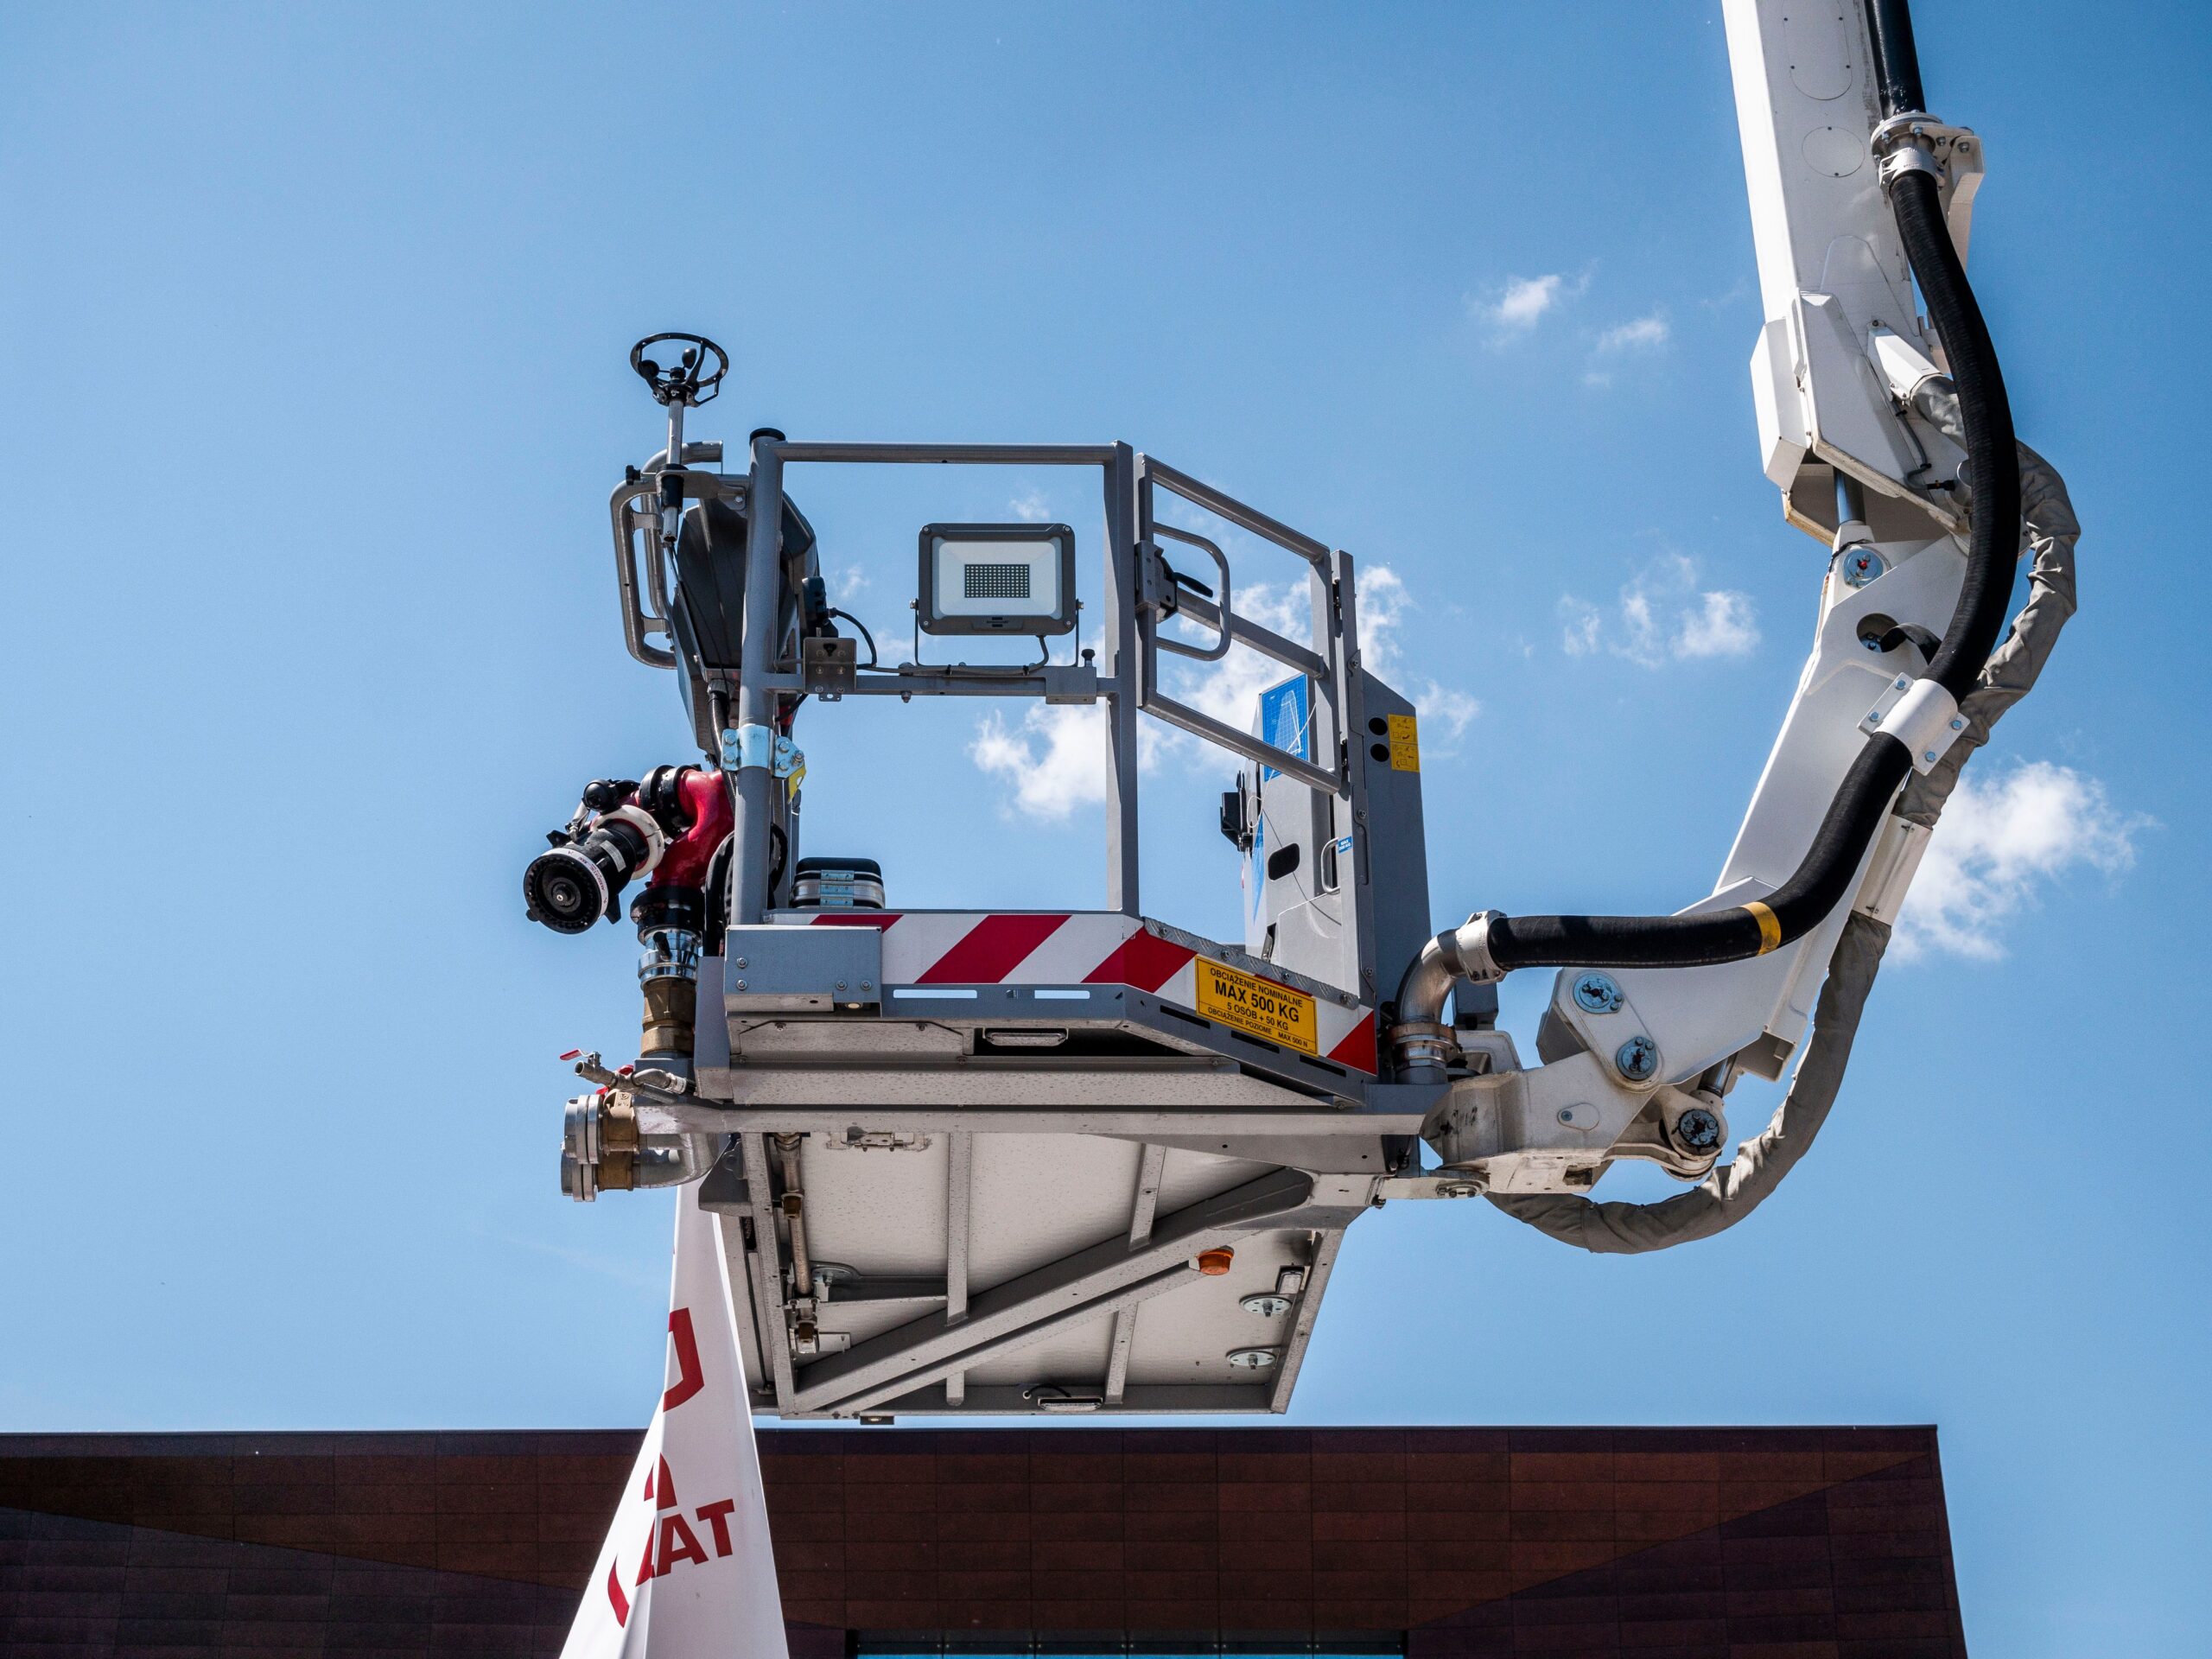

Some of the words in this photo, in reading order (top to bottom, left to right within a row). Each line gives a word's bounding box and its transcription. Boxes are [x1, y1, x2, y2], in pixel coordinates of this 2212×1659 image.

[1211, 968, 1257, 991] OBCIĄŻENIE
[1258, 985, 1303, 1007] NOMINALNE
[1215, 980, 1247, 1004] MAX
[1251, 993, 1274, 1014] 500
[1279, 1002, 1299, 1023] KG
[1208, 1007, 1244, 1025] OBCIĄŻENIE
[1245, 1020, 1272, 1035] POZIOME
[1278, 1032, 1291, 1042] MAX
[1293, 1037, 1302, 1046] 500
[1234, 1004, 1257, 1020] OSÓB
[1266, 1015, 1274, 1026] 50
[1277, 1020, 1288, 1031] KG
